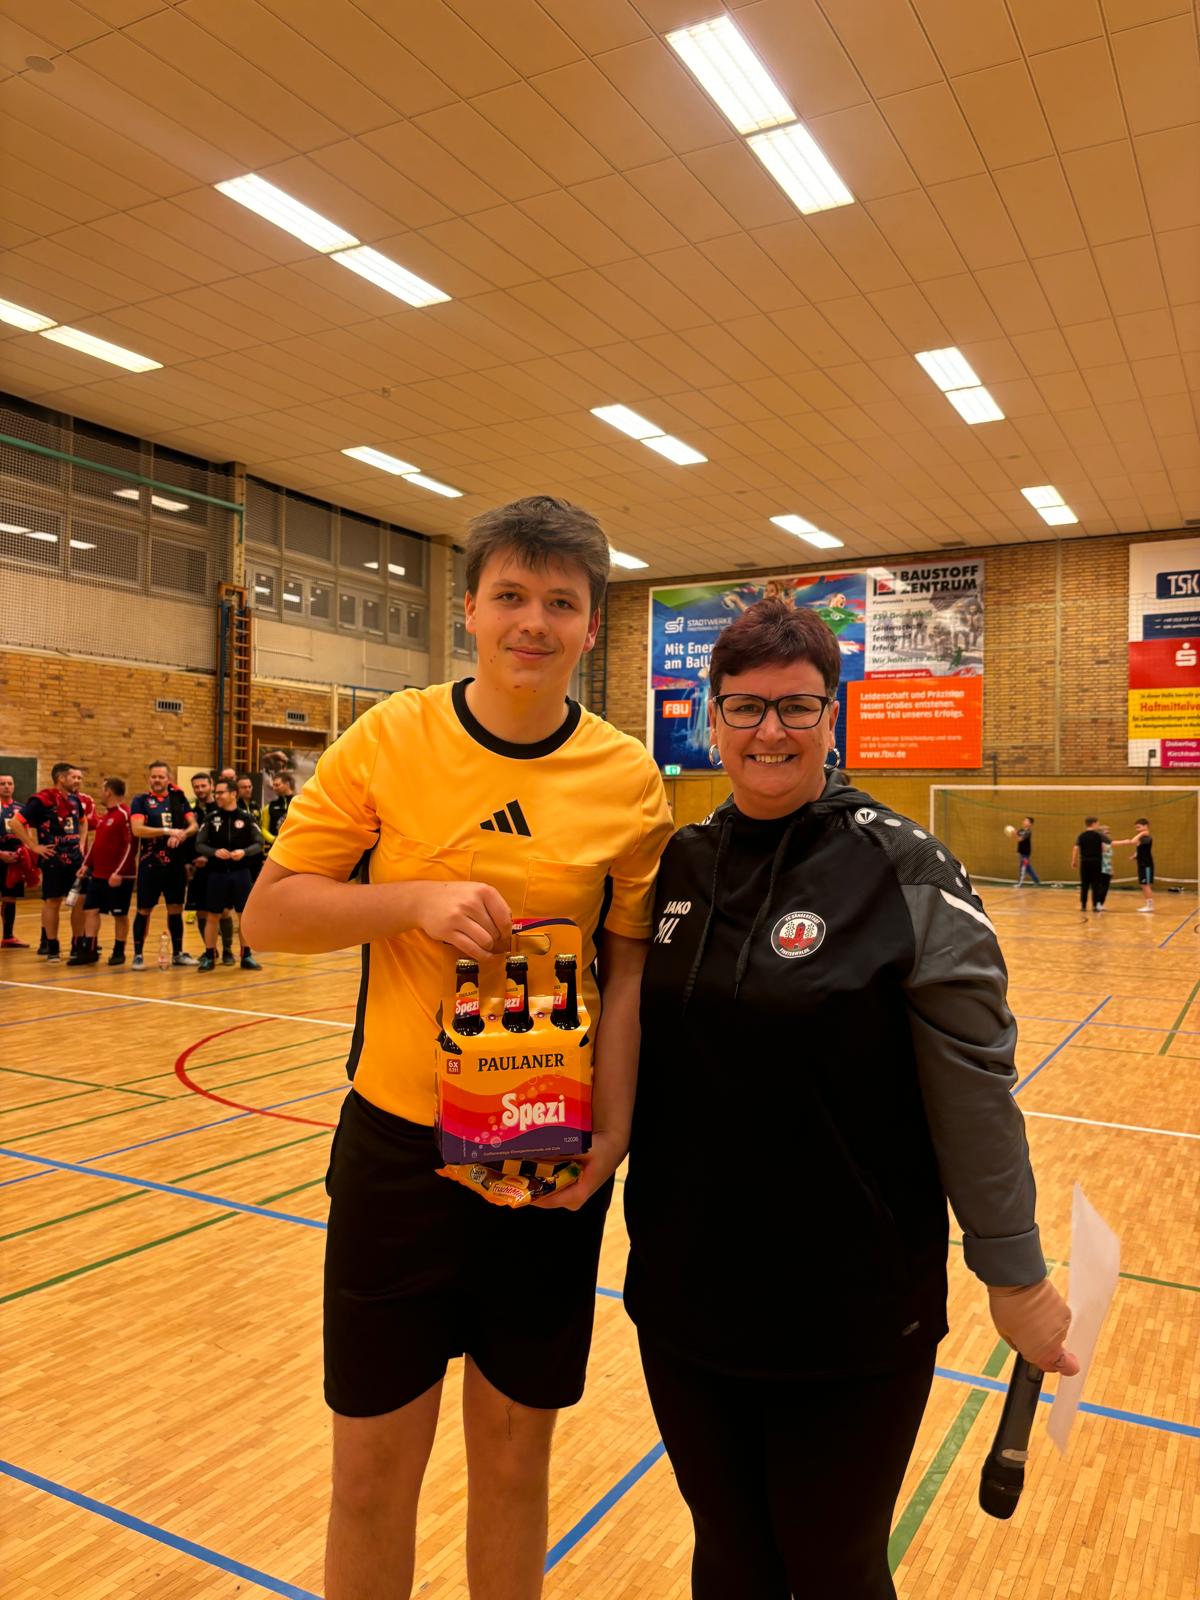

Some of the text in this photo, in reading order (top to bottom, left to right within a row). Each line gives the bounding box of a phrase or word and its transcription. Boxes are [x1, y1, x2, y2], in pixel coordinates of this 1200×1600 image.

[900, 565, 979, 581] BAUSTOFF
[687, 617, 732, 626] STADTWERKE
[664, 641, 715, 656] Mit Ener
[664, 659, 682, 670] am
[860, 690, 965, 701] Leidenschaft und Präzision
[665, 703, 689, 715] FBU
[860, 701, 955, 710] lassen Großes entstehen.
[1140, 701, 1200, 713] Haftmittelve
[860, 710, 964, 719] Werde Teil unseres Erfolgs.
[860, 751, 907, 759] www.fbu.de
[663, 900, 692, 915] JAKO
[455, 999, 480, 1016] Spezi
[504, 995, 520, 1009] ezi
[448, 1060, 459, 1068] 6x
[477, 1053, 565, 1072] PAULANER
[501, 1092, 566, 1131] Spezi
